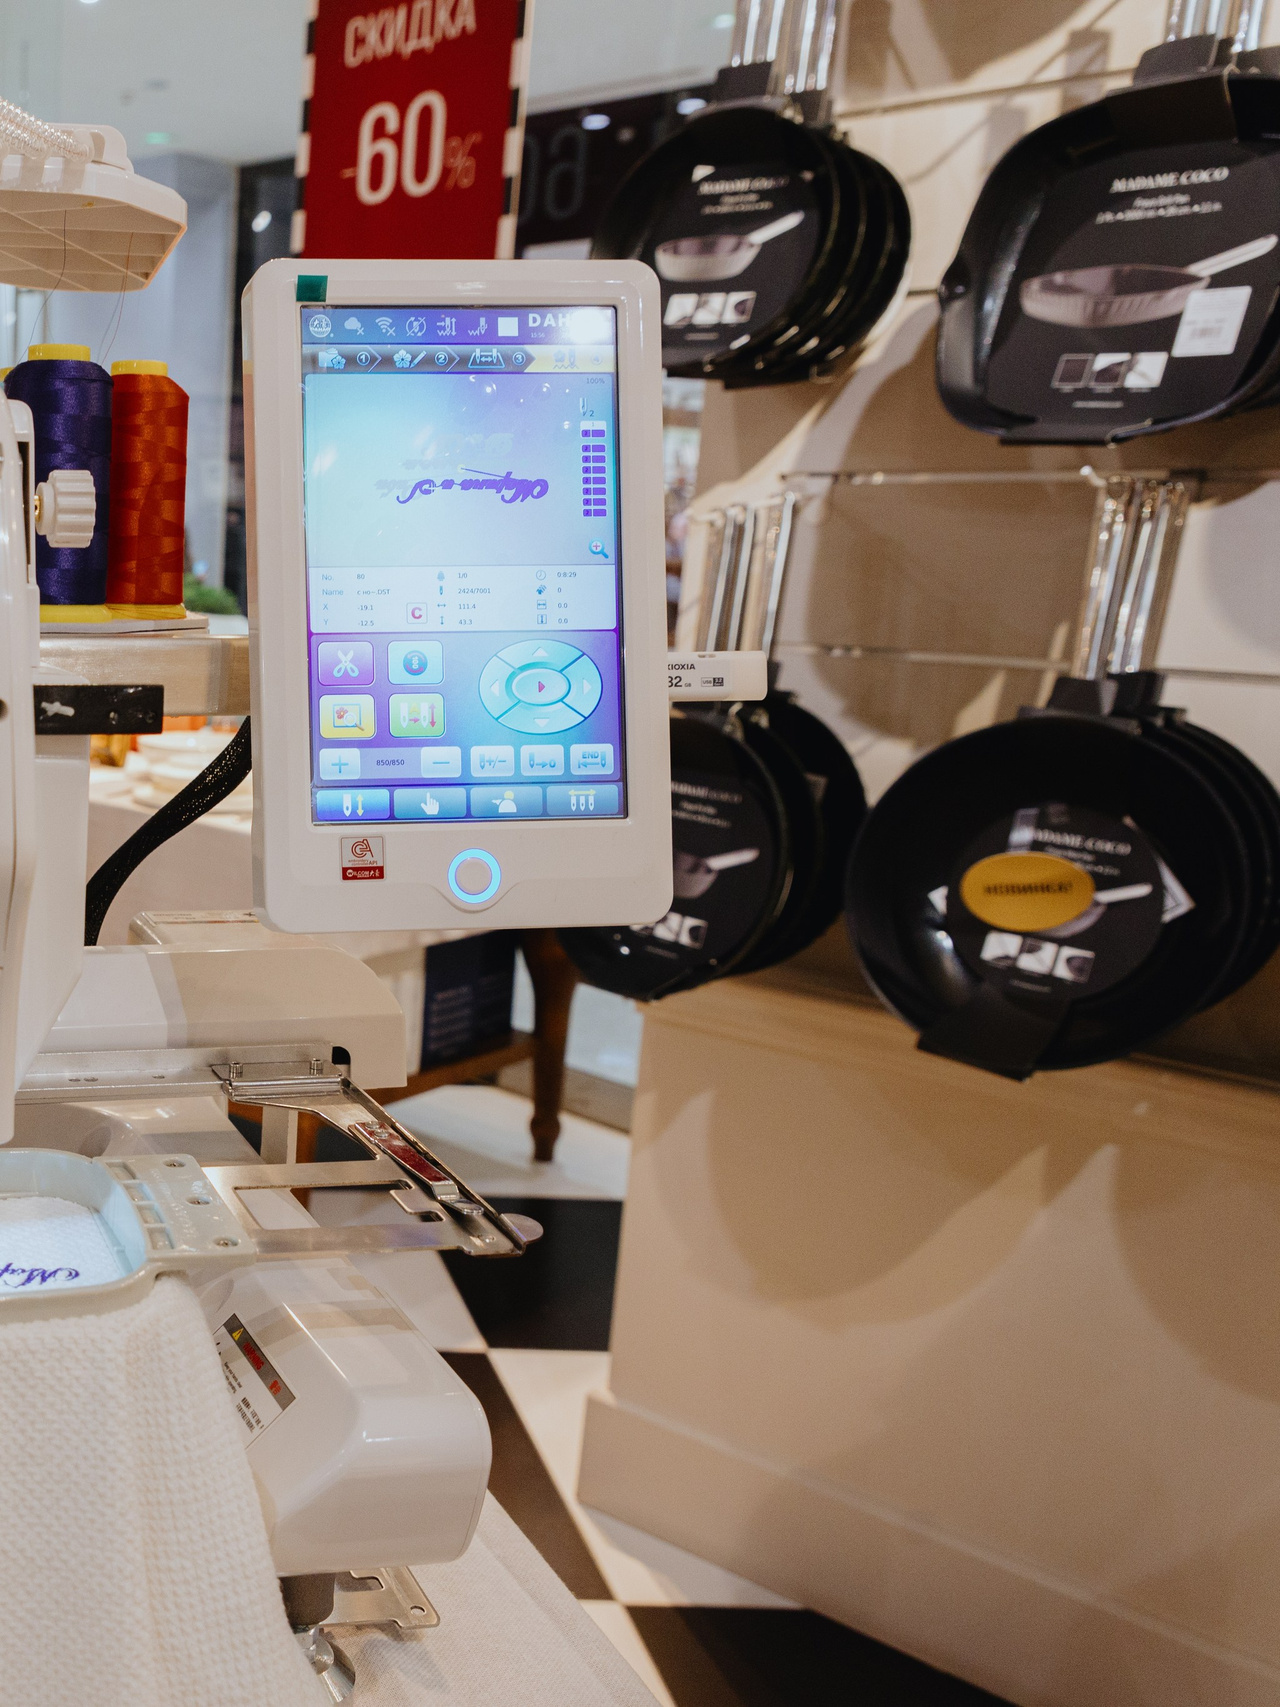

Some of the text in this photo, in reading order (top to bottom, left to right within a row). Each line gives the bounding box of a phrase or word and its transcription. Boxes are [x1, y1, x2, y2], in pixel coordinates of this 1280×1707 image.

[344, 0, 477, 68] СКИДКА
[1180, 166, 1230, 186] COCO
[582, 751, 600, 759] END
